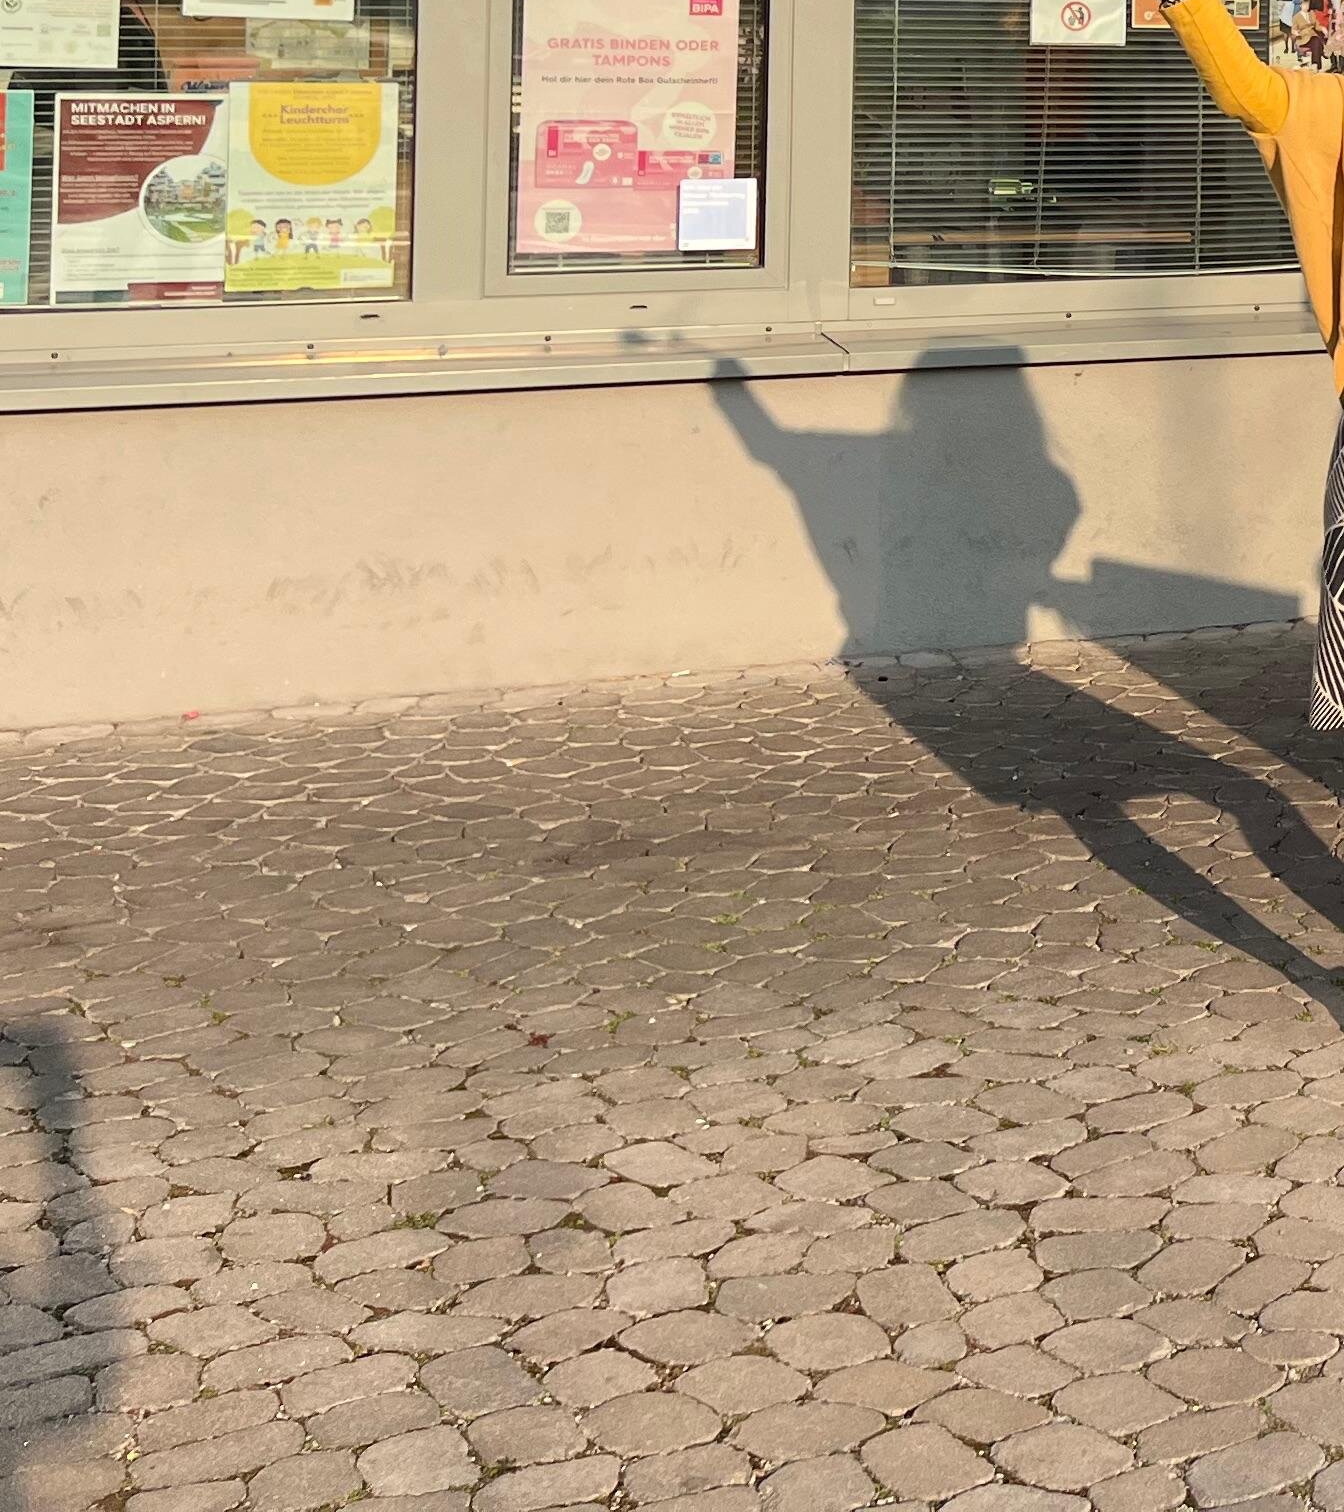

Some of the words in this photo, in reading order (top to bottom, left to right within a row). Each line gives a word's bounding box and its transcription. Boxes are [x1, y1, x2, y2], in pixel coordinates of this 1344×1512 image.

[692, 4, 719, 13] BIPA
[547, 37, 605, 49] GRATIS
[610, 39, 670, 51] BINDEN
[676, 40, 719, 51] ODER
[592, 54, 671, 67] TAMPONS
[71, 103, 158, 114] MITMACHEN
[161, 103, 175, 114] IN
[71, 114, 144, 126] SEESTADT
[147, 115, 206, 126] ASPERN!
